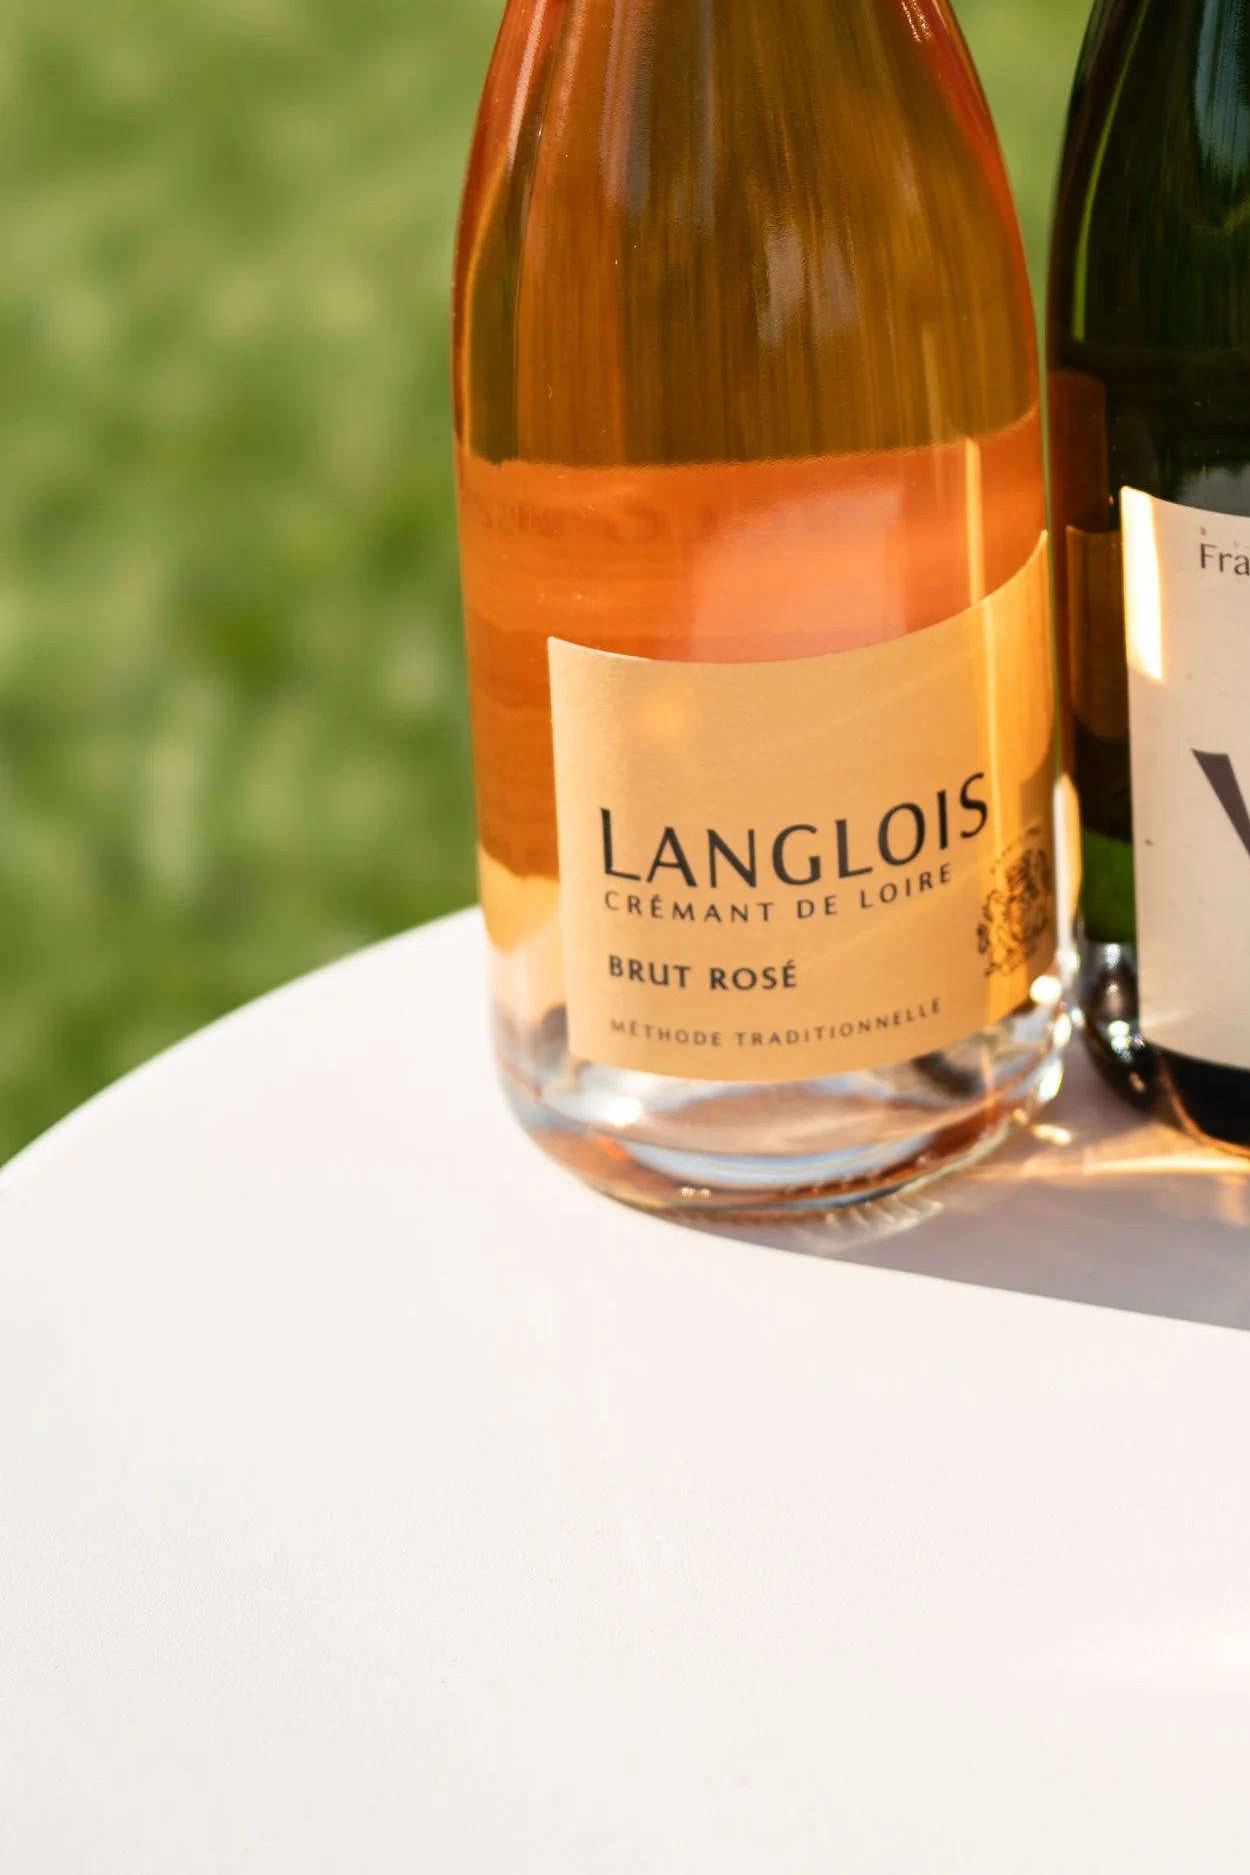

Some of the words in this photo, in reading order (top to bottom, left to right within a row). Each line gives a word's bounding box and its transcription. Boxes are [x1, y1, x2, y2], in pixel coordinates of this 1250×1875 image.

[600, 772, 988, 889] LANGLOIS
[604, 890, 775, 923] CRÉMANT
[796, 894, 838, 919] DE
[860, 862, 951, 909] LOIRE
[609, 954, 692, 989] BRUT
[708, 959, 797, 991] ROSÉ
[610, 1018, 722, 1047] MÉTHODE
[735, 997, 941, 1047] TRADITIONNELLE
